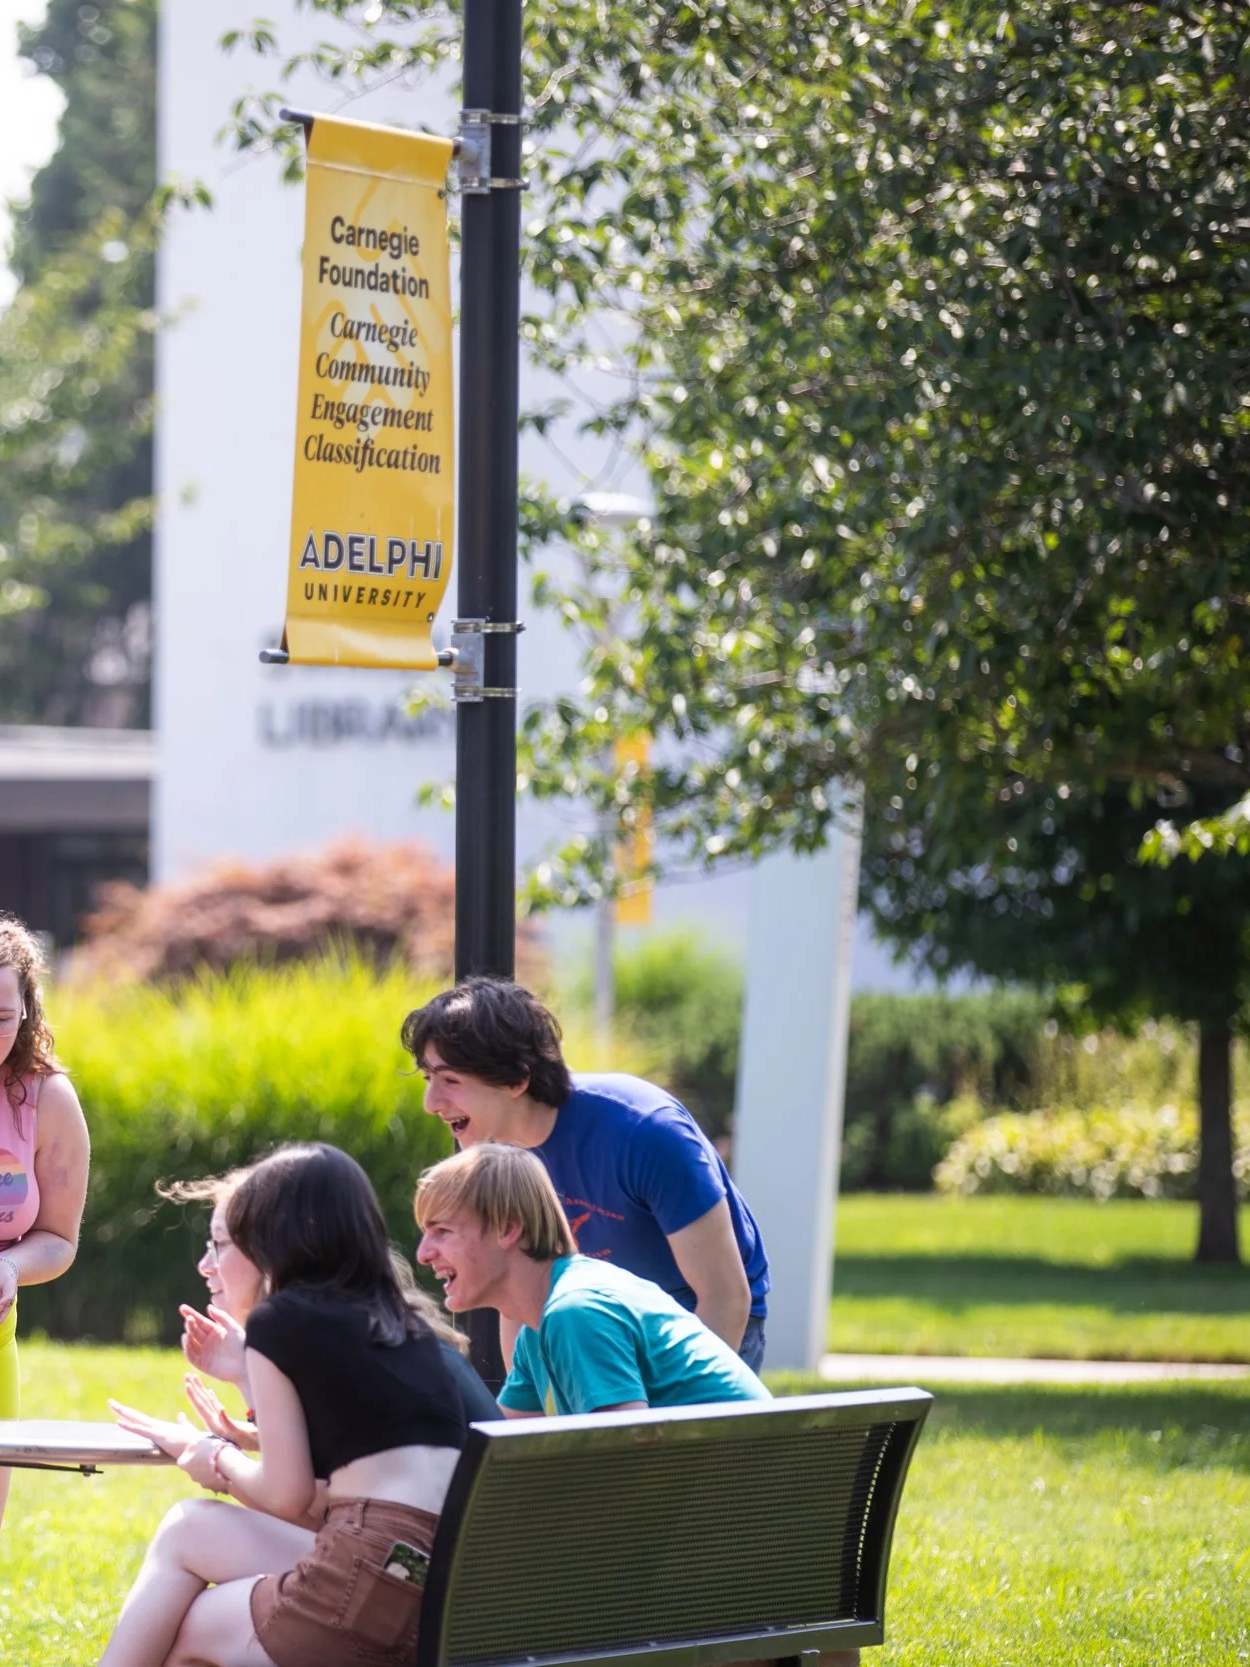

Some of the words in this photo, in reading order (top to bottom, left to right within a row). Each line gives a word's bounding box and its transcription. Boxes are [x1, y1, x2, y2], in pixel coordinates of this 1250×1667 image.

[330, 215, 419, 260] Carnegie
[319, 255, 430, 299] Foundation
[330, 311, 418, 353] Carnegie
[316, 351, 430, 397] Community
[310, 393, 434, 432] Engagement
[304, 434, 441, 474] Classification
[299, 528, 443, 581] ADELPHI
[305, 582, 426, 609] UNIVERSITY
